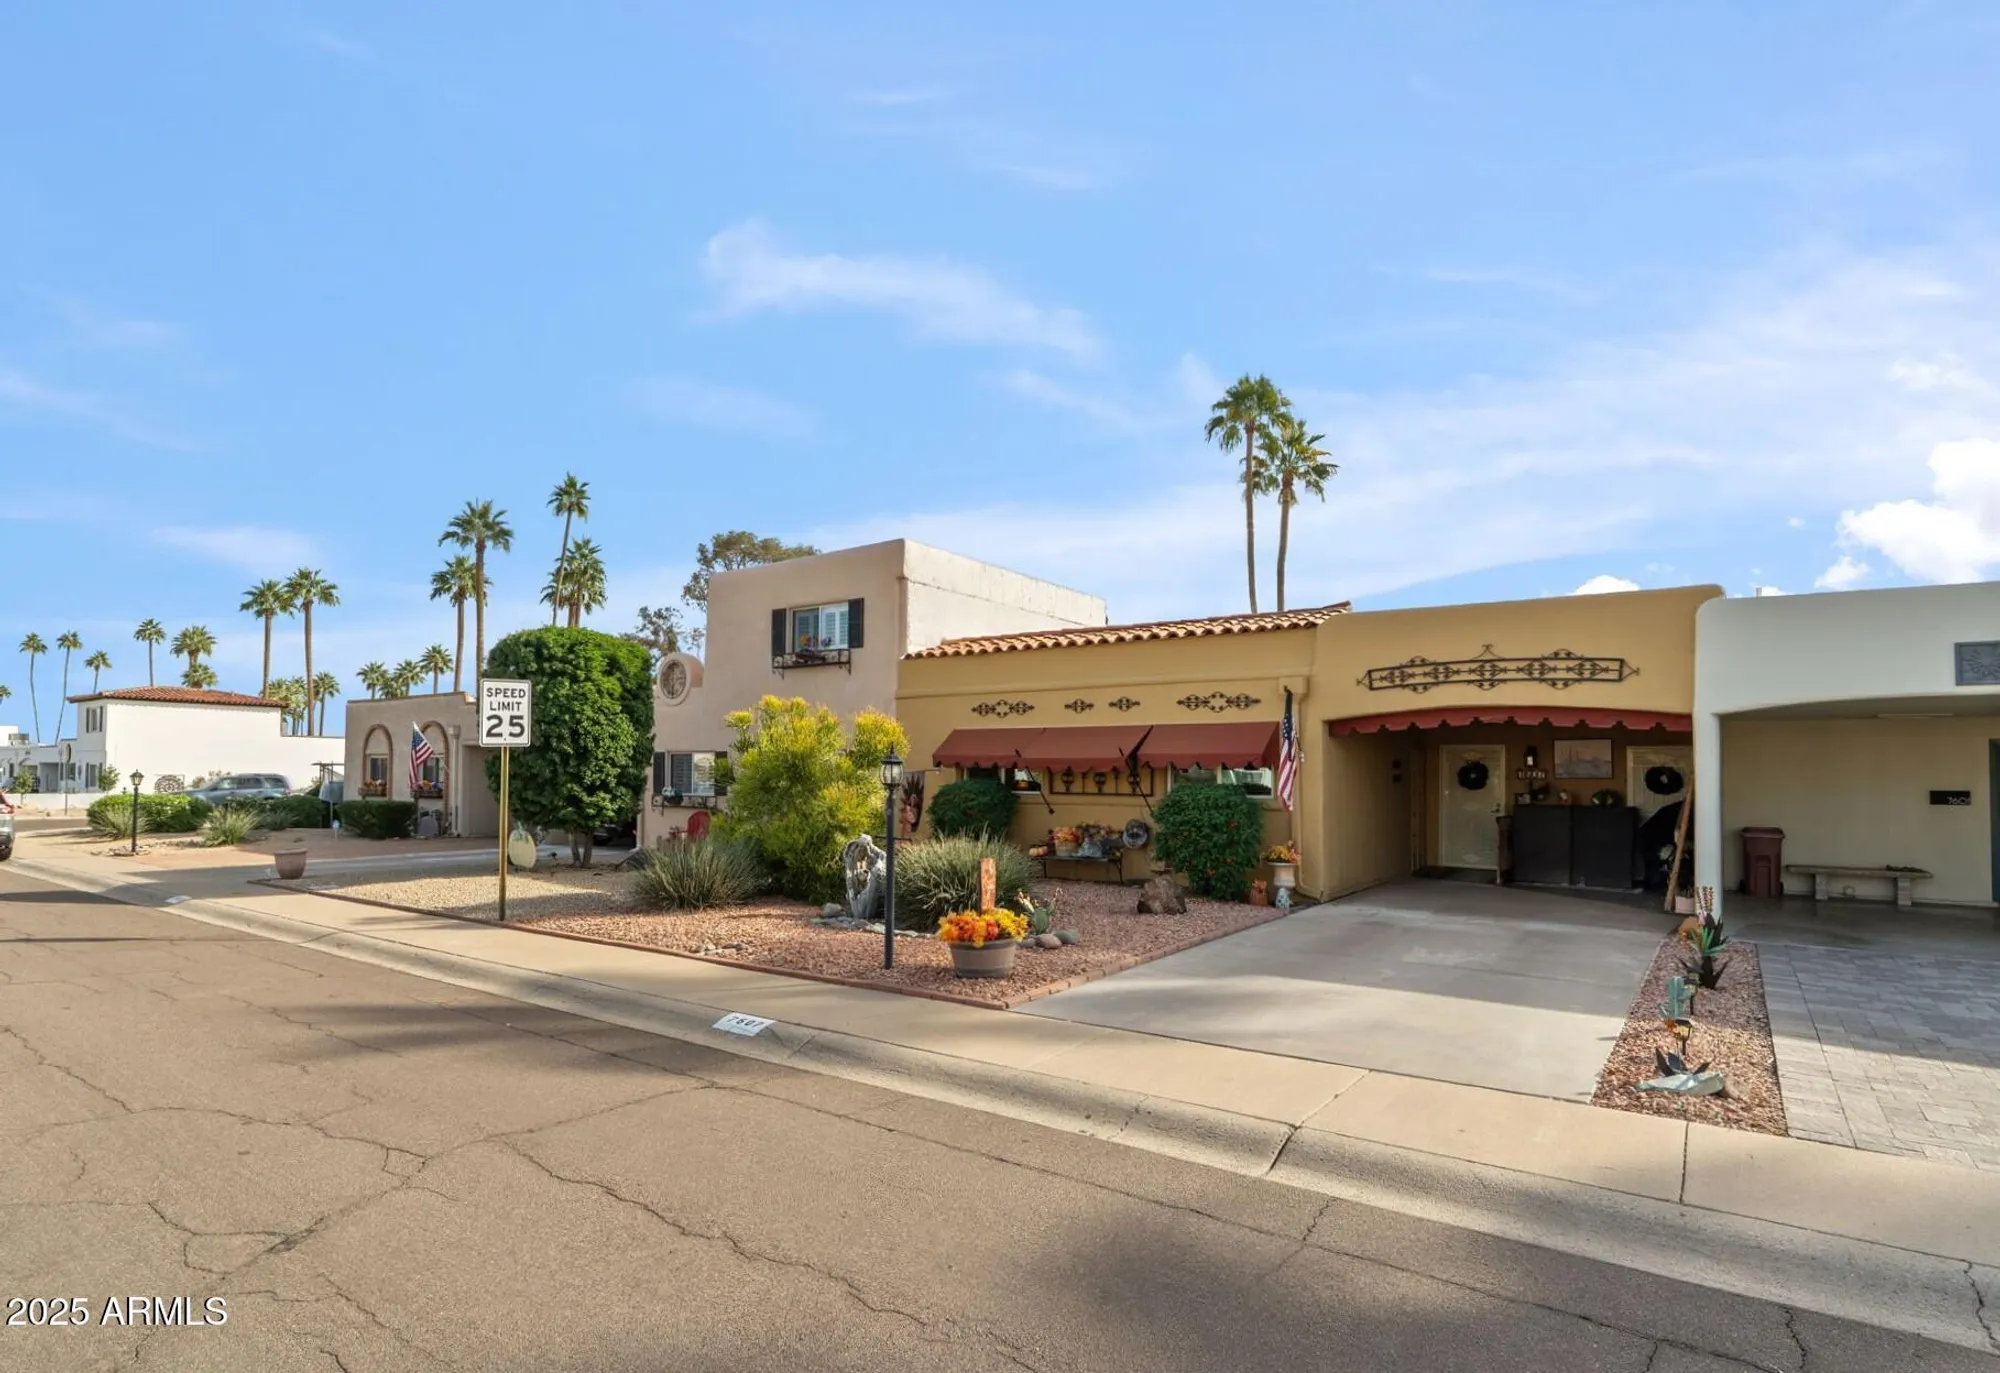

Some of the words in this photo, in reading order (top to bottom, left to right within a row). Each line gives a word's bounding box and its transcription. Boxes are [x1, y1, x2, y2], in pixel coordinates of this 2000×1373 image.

[486, 687, 526, 698] SPEED
[490, 701, 522, 711] LIMIT
[486, 714, 525, 738] 25
